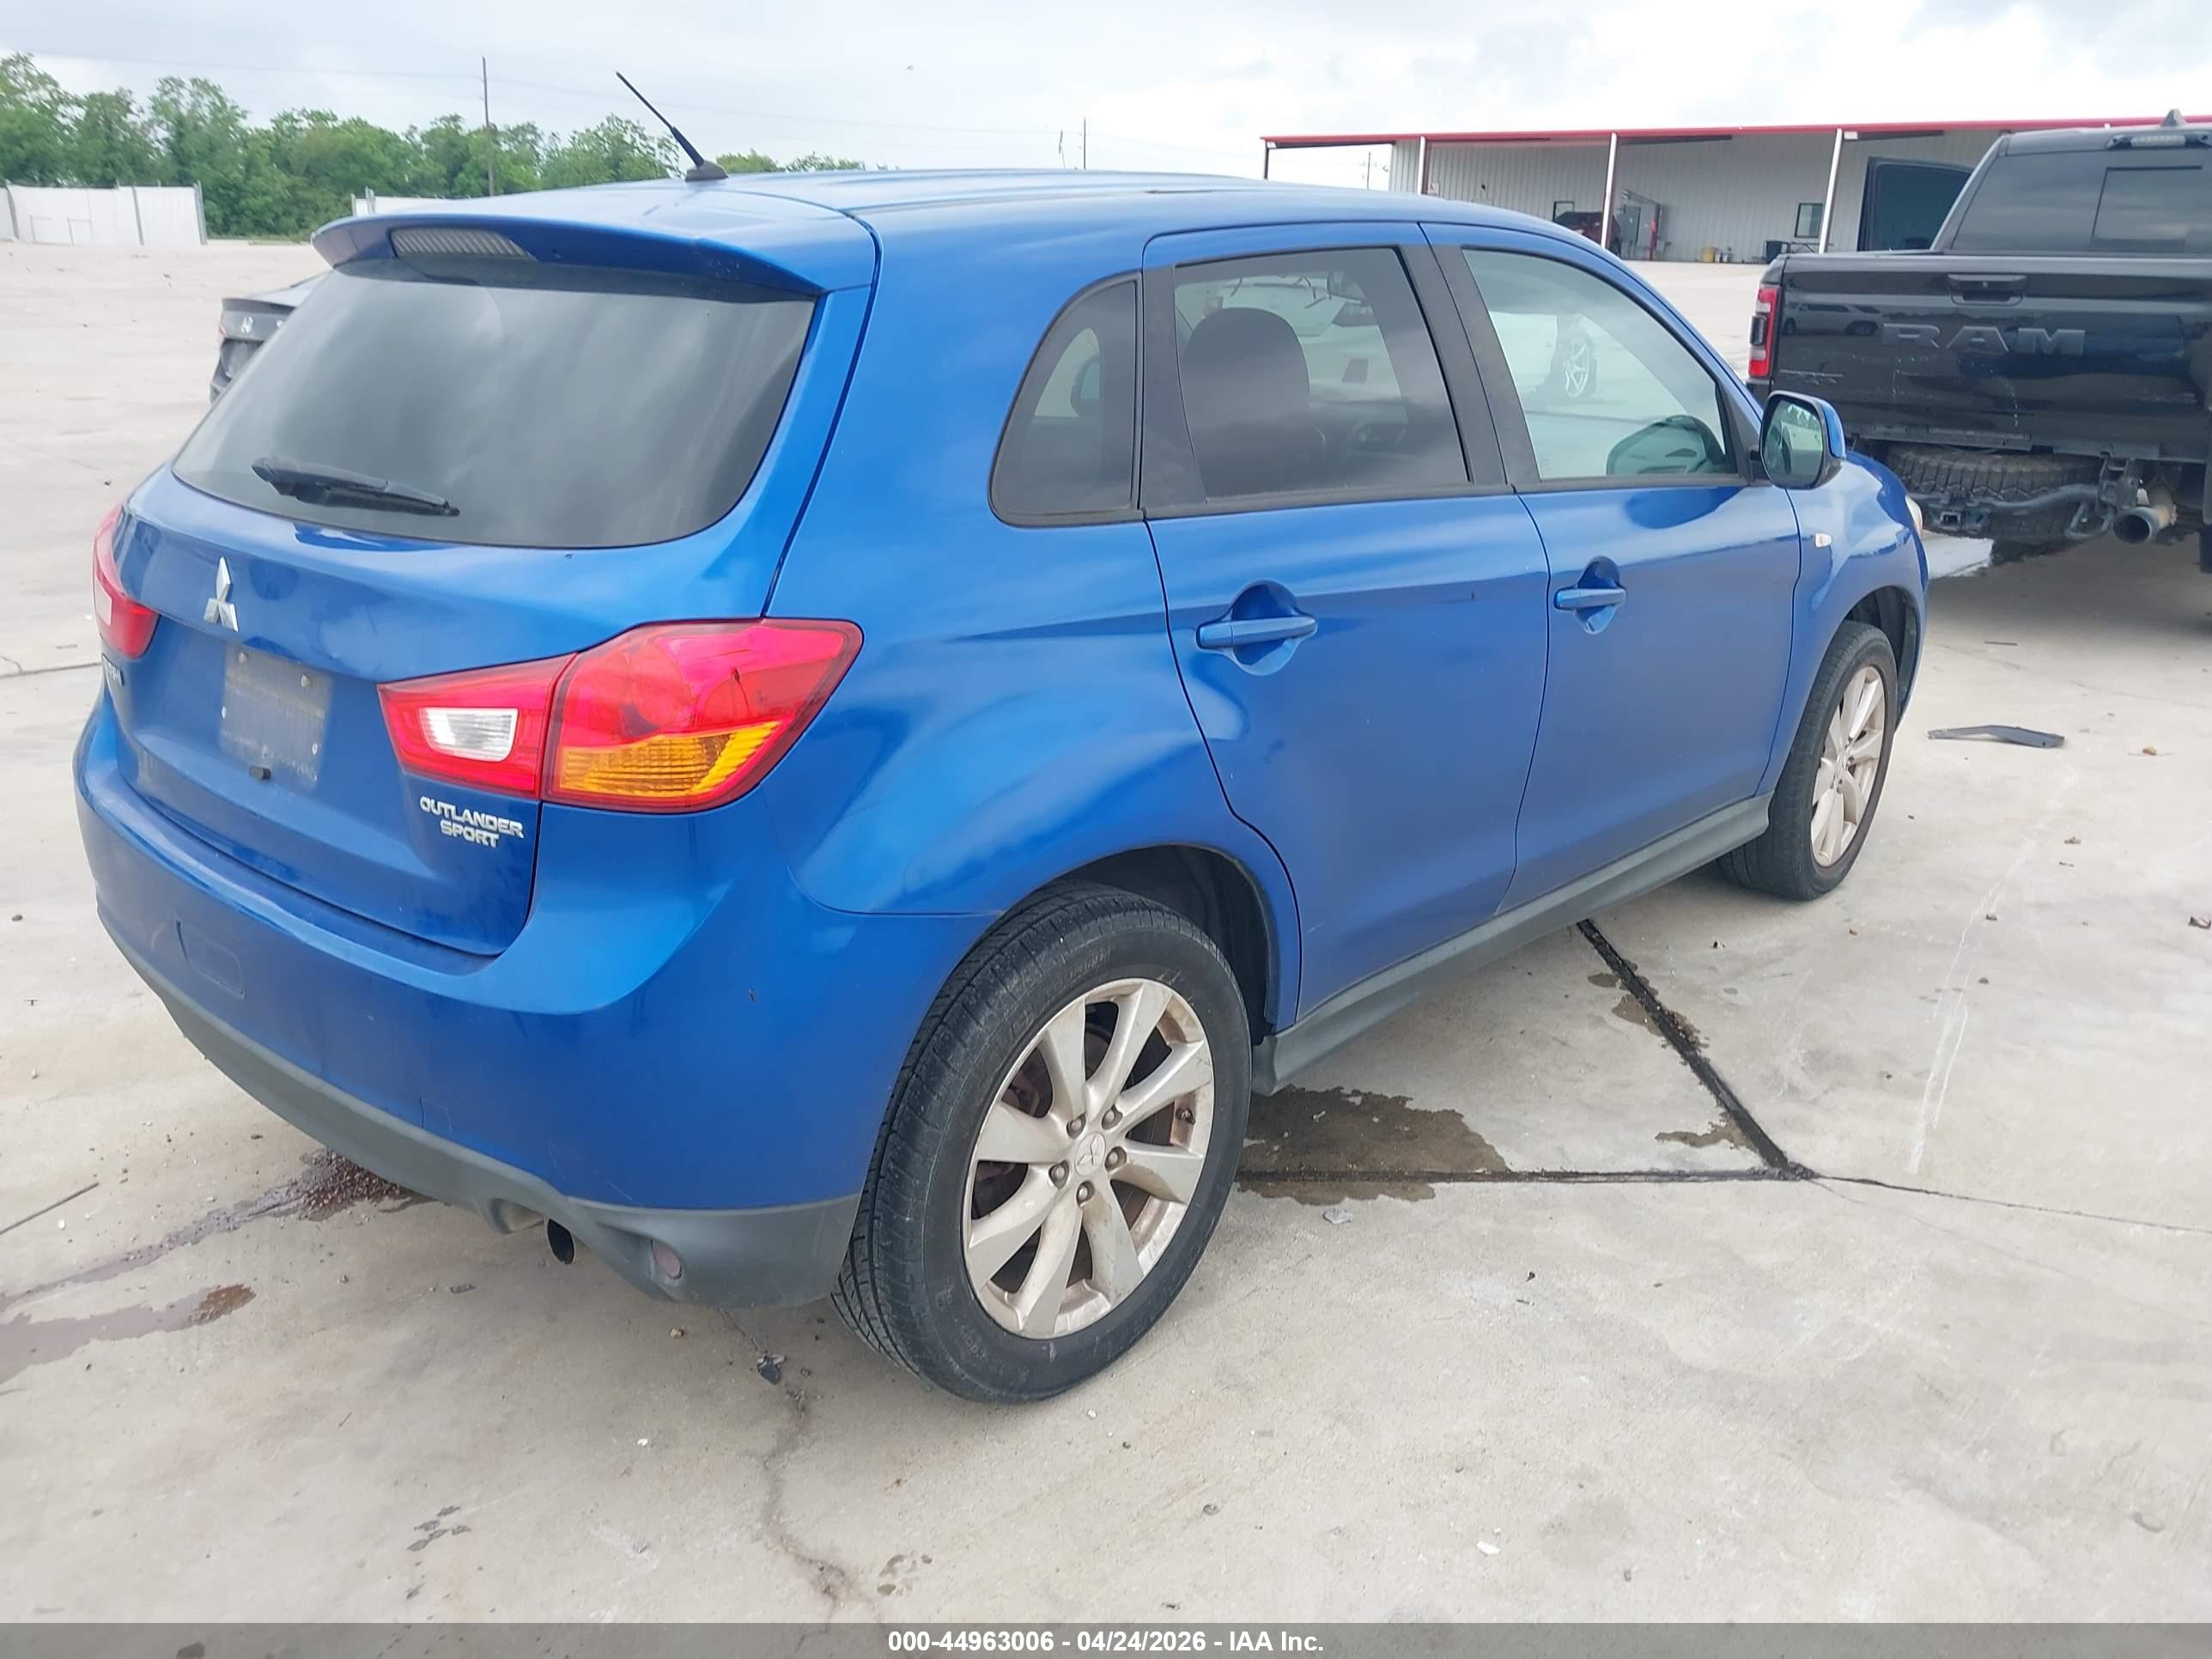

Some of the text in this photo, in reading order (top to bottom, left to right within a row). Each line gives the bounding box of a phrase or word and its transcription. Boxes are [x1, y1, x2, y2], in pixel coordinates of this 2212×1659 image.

[1881, 322, 2086, 356] RAM
[419, 795, 525, 839] OUTLANDER
[439, 818, 500, 848] SPORT
